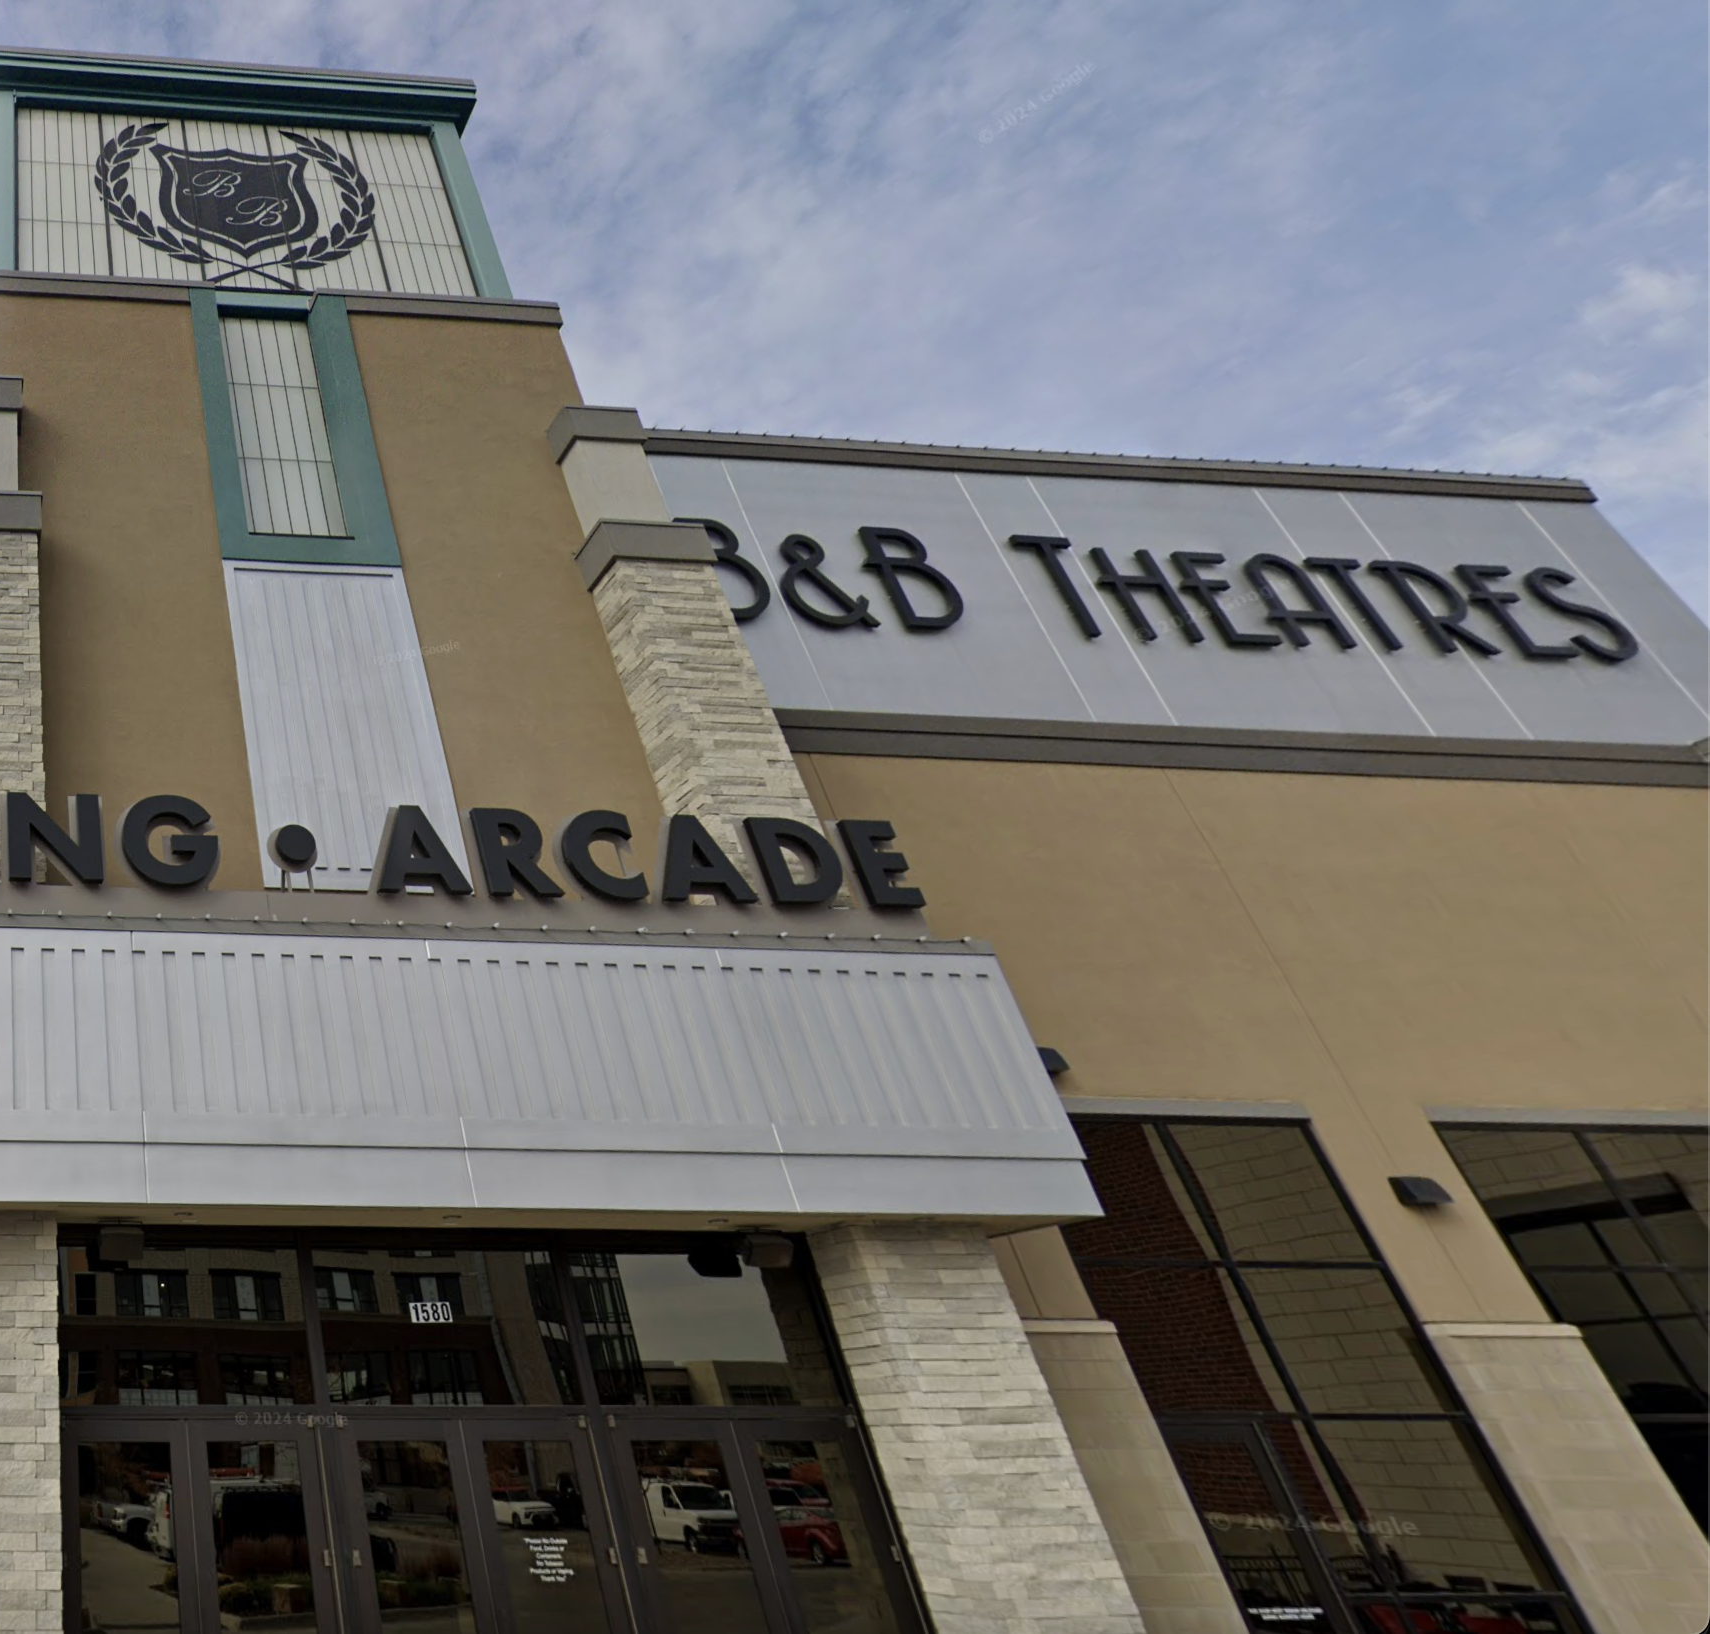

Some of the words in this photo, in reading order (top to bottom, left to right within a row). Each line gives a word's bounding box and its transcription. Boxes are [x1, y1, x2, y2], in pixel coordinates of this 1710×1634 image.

[182, 169, 242, 198] B
[225, 196, 288, 227] B
[1008, 533, 1639, 663] THEATRES
[377, 804, 926, 909] ARCADE
[411, 1303, 450, 1322] 1580
